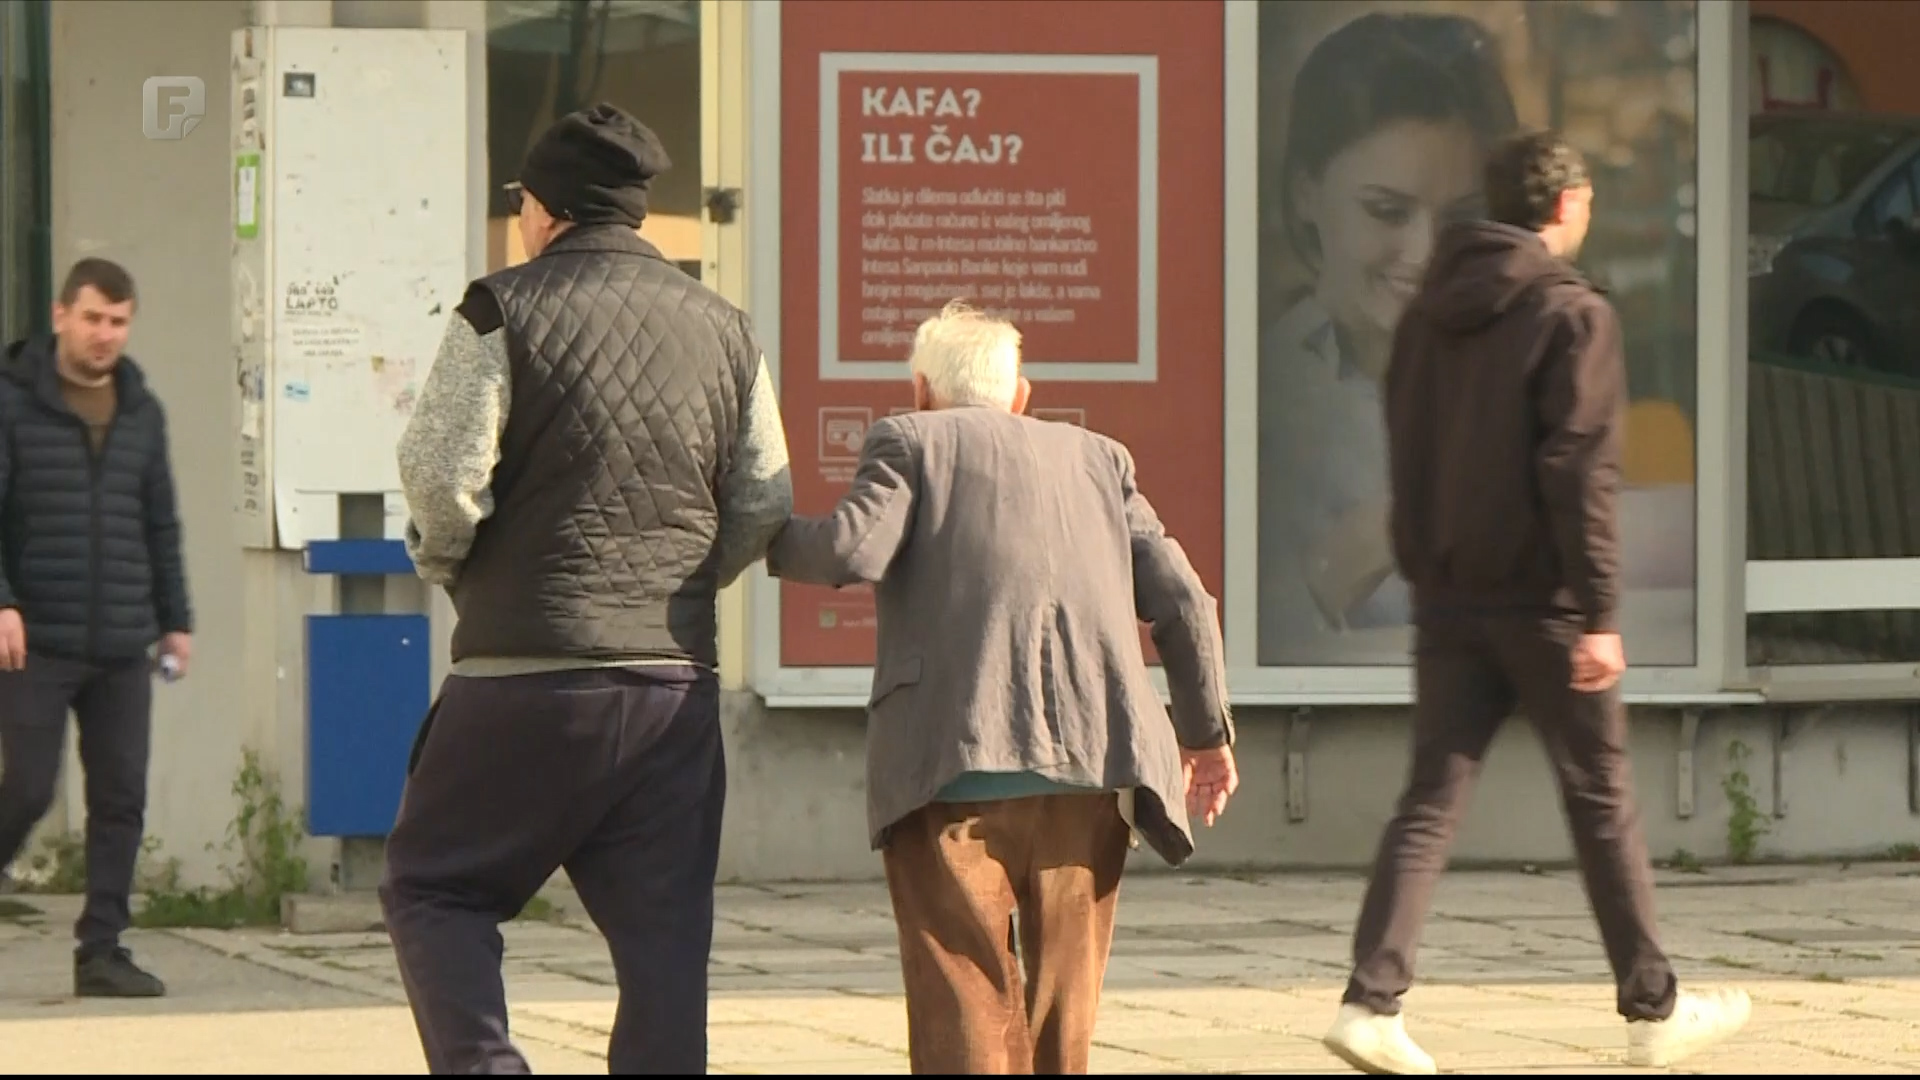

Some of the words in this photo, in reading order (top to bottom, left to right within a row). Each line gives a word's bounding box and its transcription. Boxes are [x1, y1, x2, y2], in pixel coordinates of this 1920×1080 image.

[861, 86, 982, 118] KAFA?
[861, 132, 915, 164] ILI
[925, 124, 1024, 165] ČAJ?
